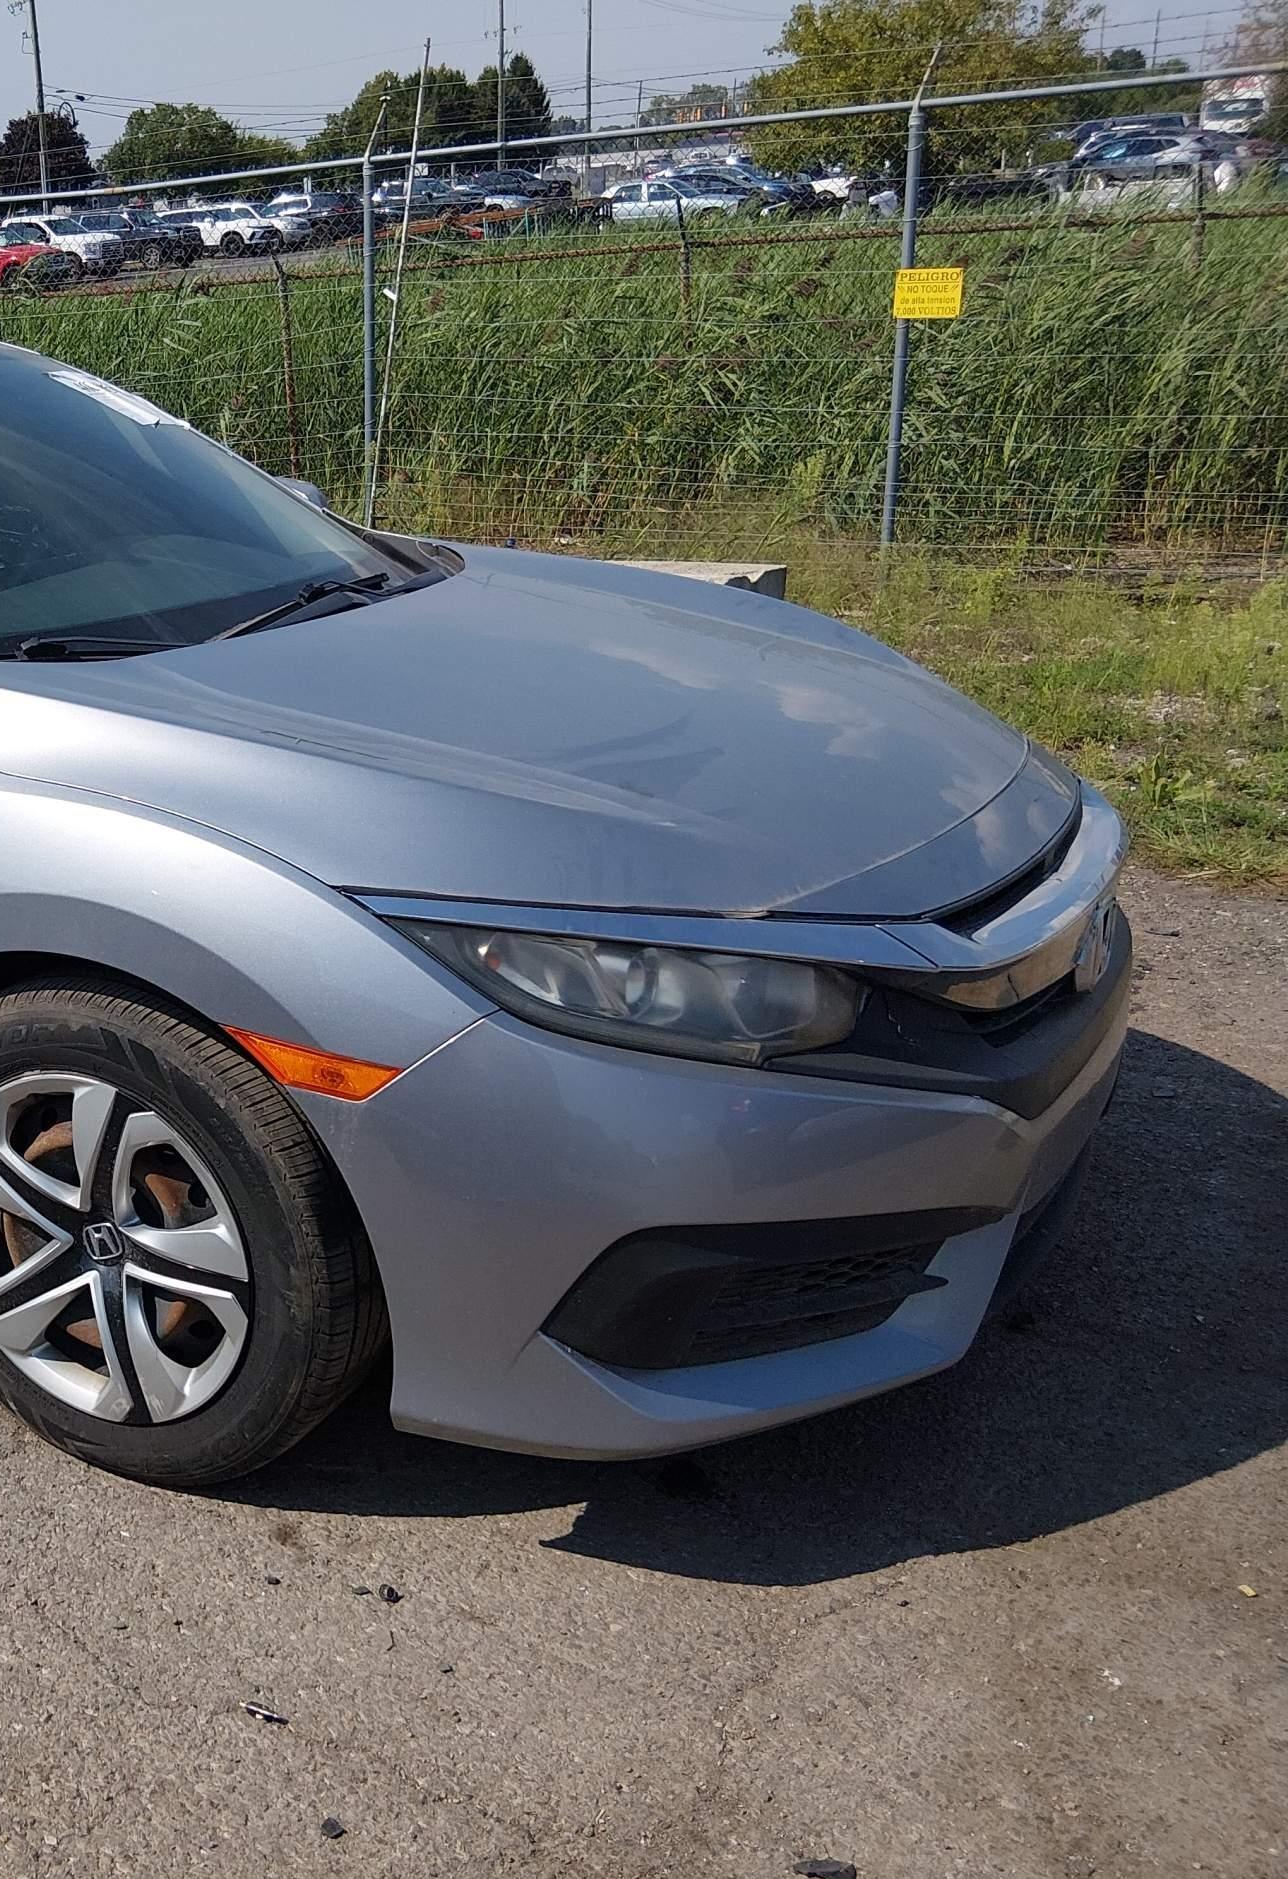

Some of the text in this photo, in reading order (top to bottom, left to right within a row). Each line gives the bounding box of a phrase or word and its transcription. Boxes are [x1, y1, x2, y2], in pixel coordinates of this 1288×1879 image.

[900, 272, 959, 281] PELIGRO
[907, 284, 949, 294] NO TOQUE
[918, 306, 956, 315] VOLTIOS
